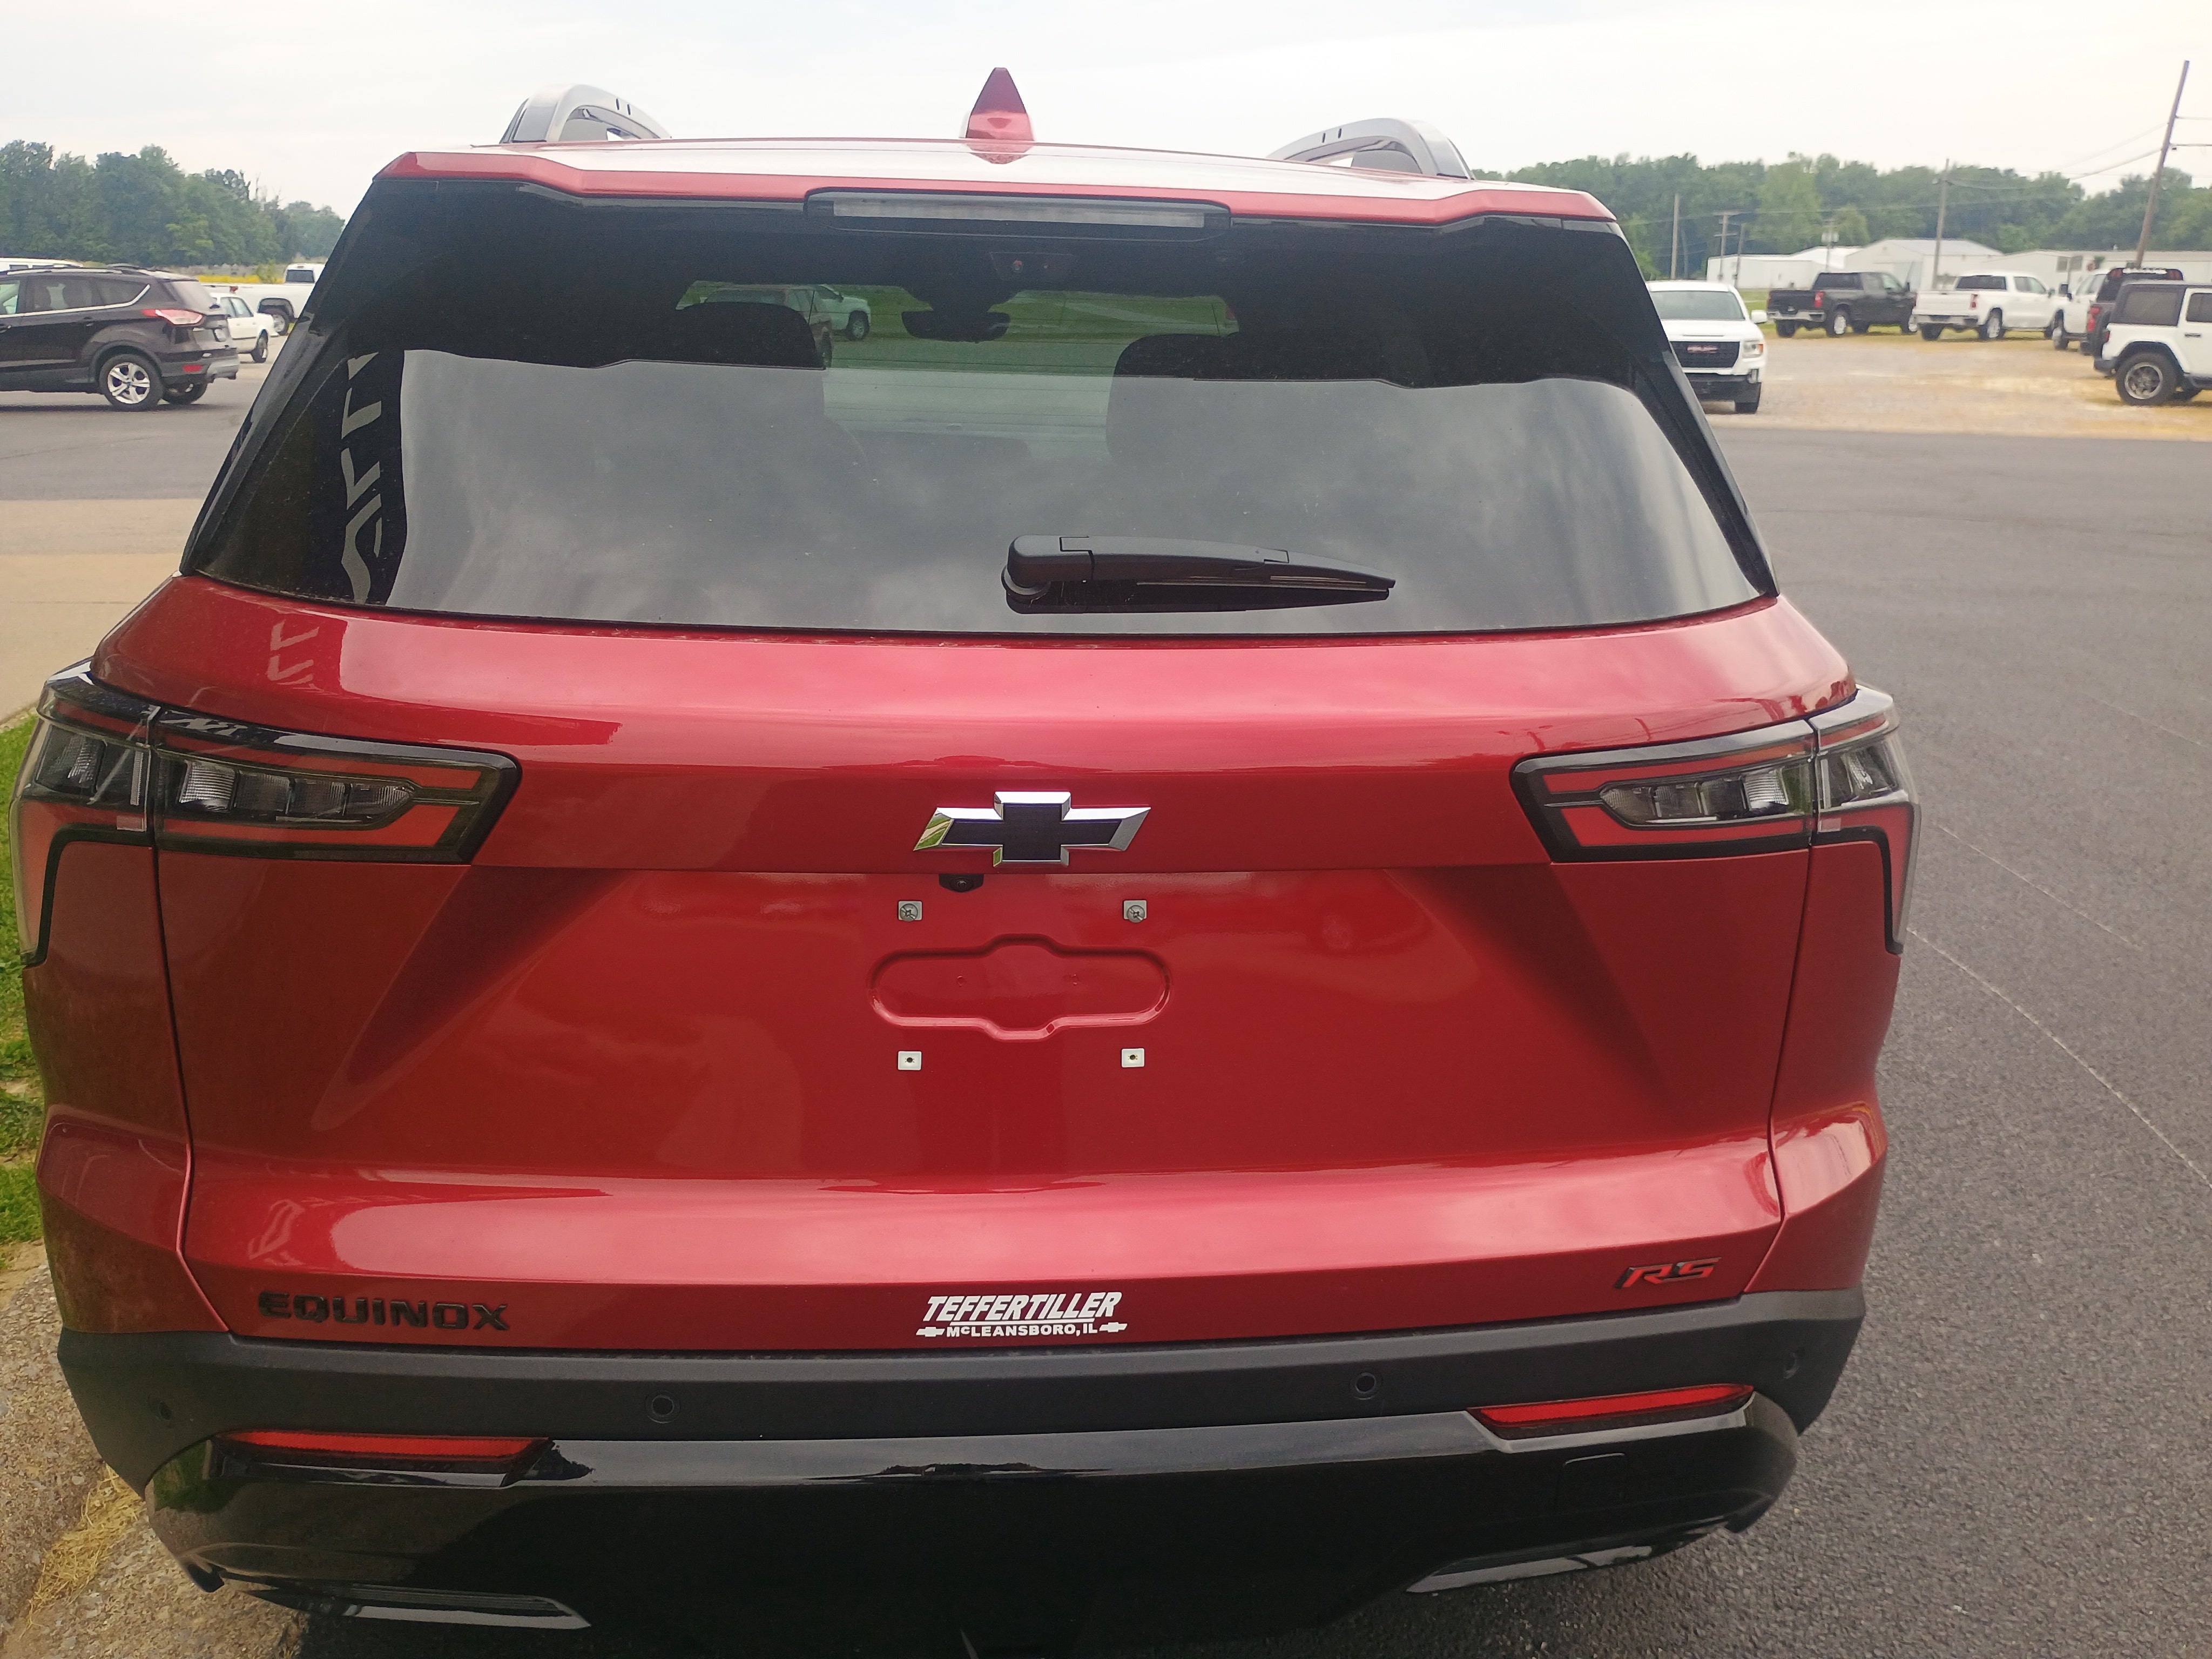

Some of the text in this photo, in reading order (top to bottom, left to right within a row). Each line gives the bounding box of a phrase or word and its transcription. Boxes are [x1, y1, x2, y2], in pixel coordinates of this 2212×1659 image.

[1613, 1257, 1722, 1289] RS
[258, 1290, 509, 1331] EQUINOX
[923, 1292, 1122, 1321] TEFFERTILLER
